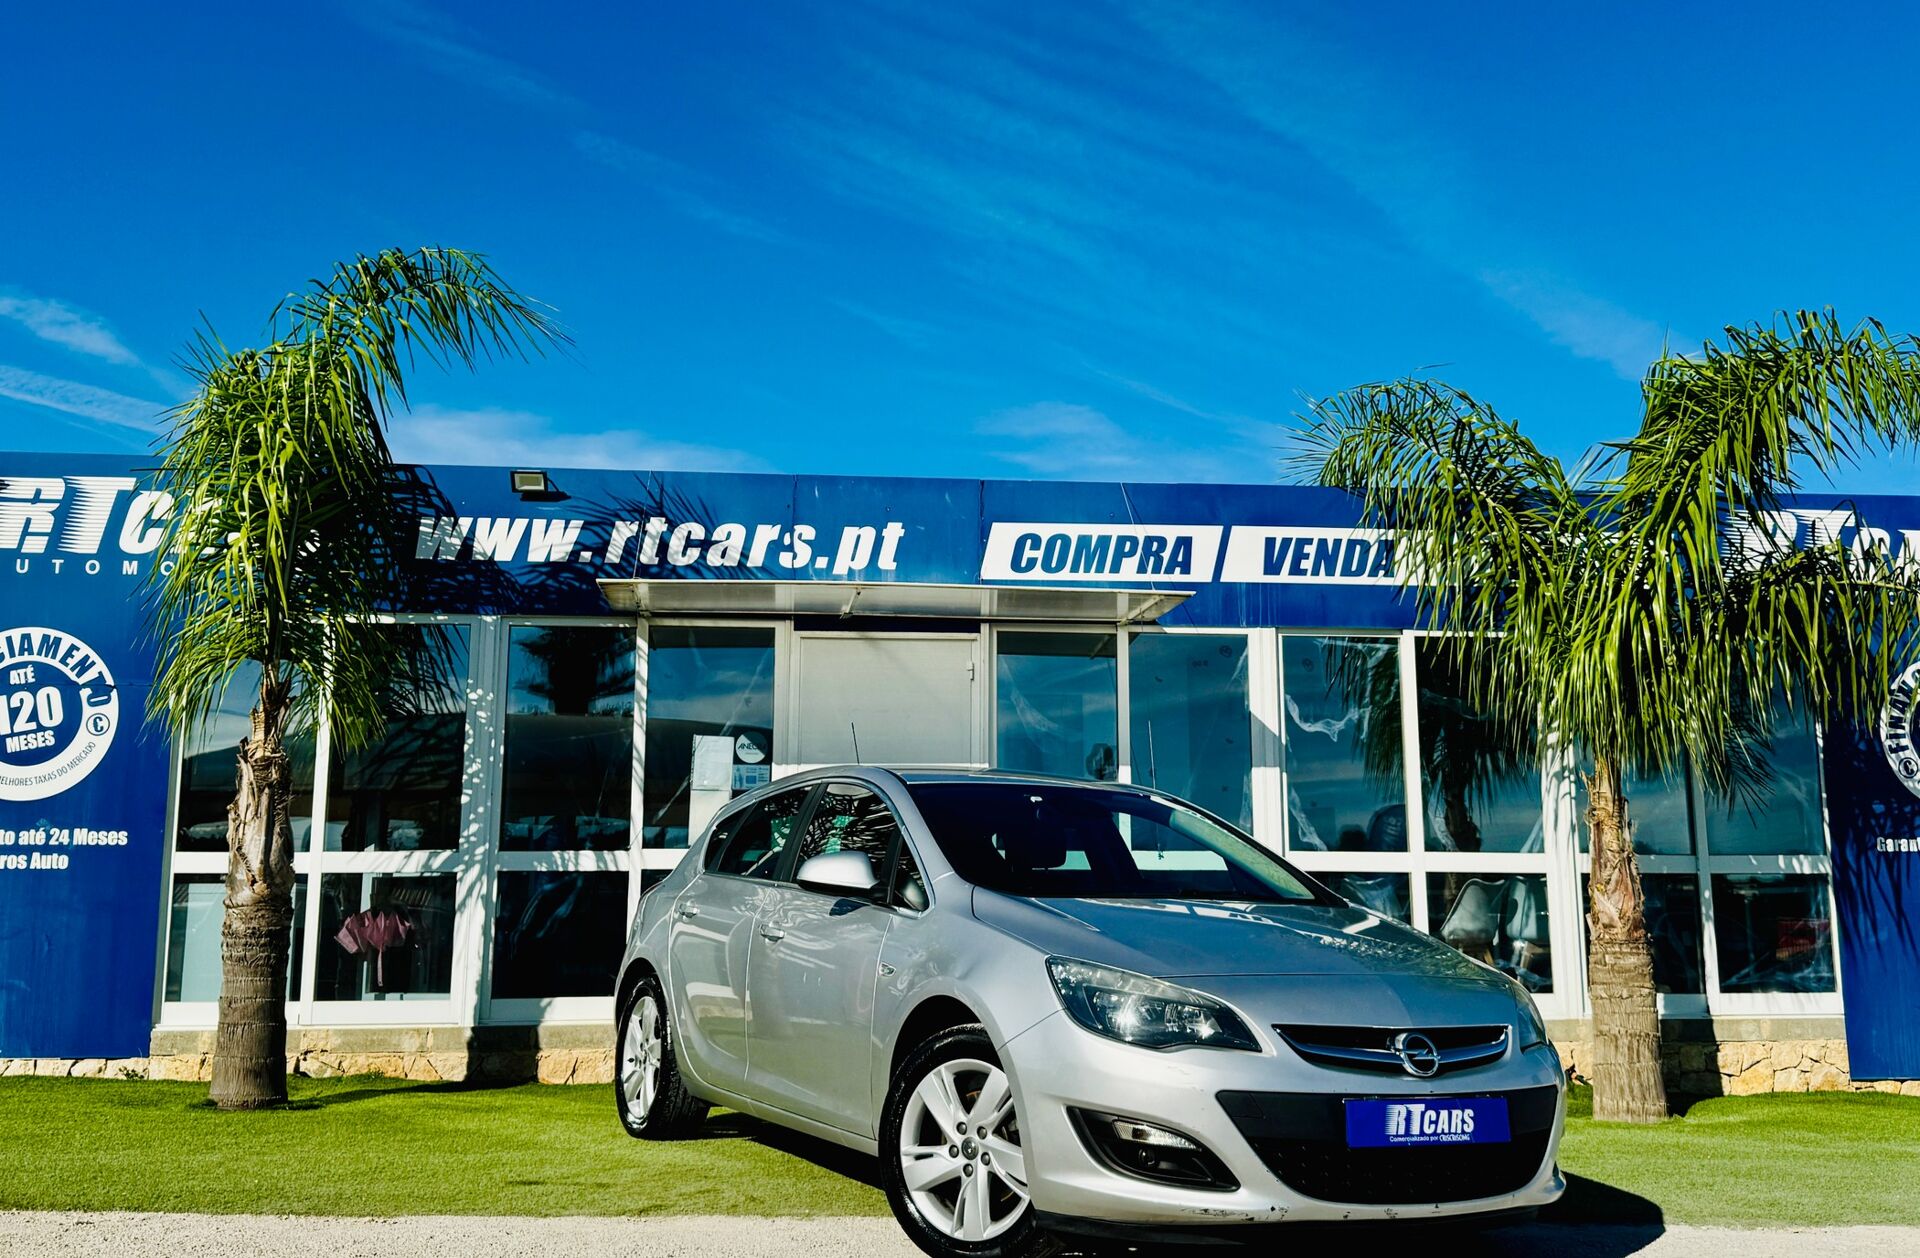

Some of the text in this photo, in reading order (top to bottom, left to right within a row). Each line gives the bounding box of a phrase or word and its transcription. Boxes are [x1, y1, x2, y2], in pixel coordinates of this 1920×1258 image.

[414, 516, 905, 575] www.rtcars.pt
[1010, 531, 1193, 576] COMPRA
[1262, 536, 1396, 579] VENDA
[9, 664, 36, 685] ATÉ
[0, 686, 64, 736] 120
[6, 730, 56, 754] MESES
[34, 771, 57, 784] TAXAS
[57, 764, 68, 777] DO
[68, 741, 96, 771] MERCADO
[18, 827, 46, 846] até
[49, 827, 70, 846] 24
[72, 827, 128, 846] Meses
[30, 852, 69, 870] Auto
